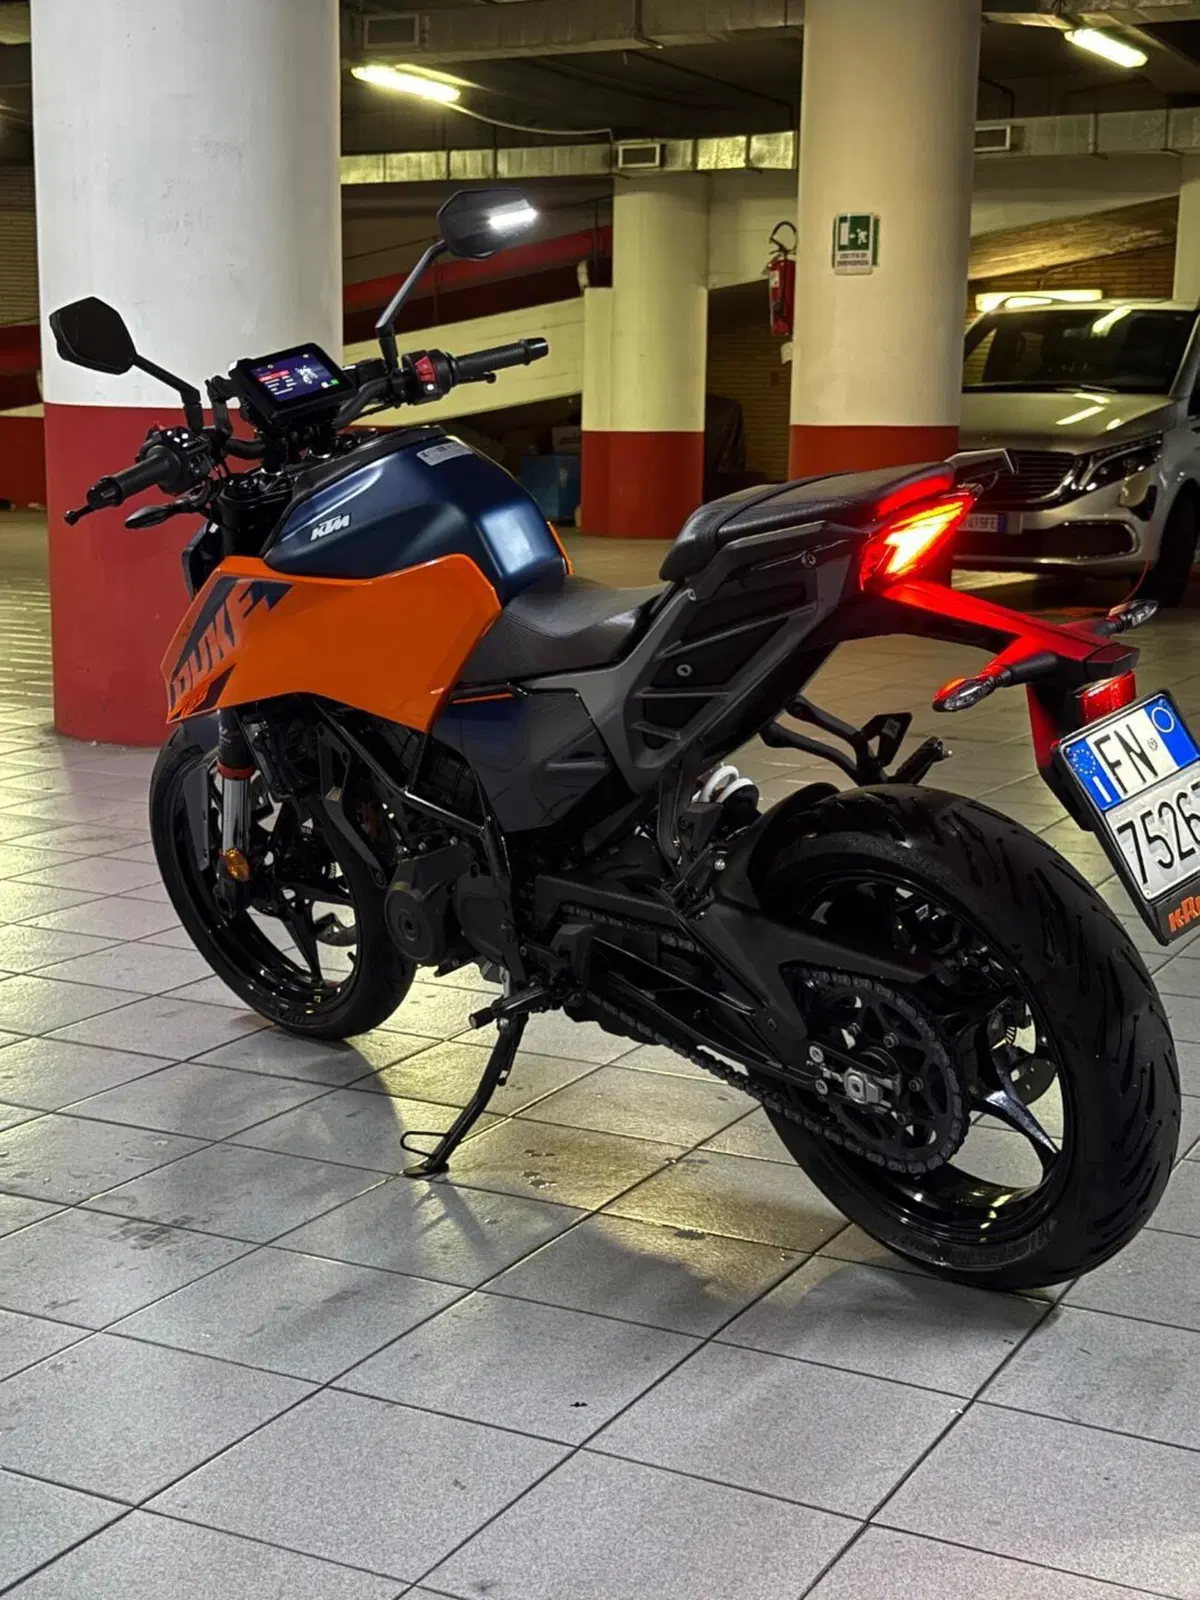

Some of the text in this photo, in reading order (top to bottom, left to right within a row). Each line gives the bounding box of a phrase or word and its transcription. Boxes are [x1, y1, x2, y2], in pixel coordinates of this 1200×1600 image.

[310, 514, 350, 541] KTM
[1092, 723, 1159, 795] FN
[1115, 780, 1200, 886] 7526
